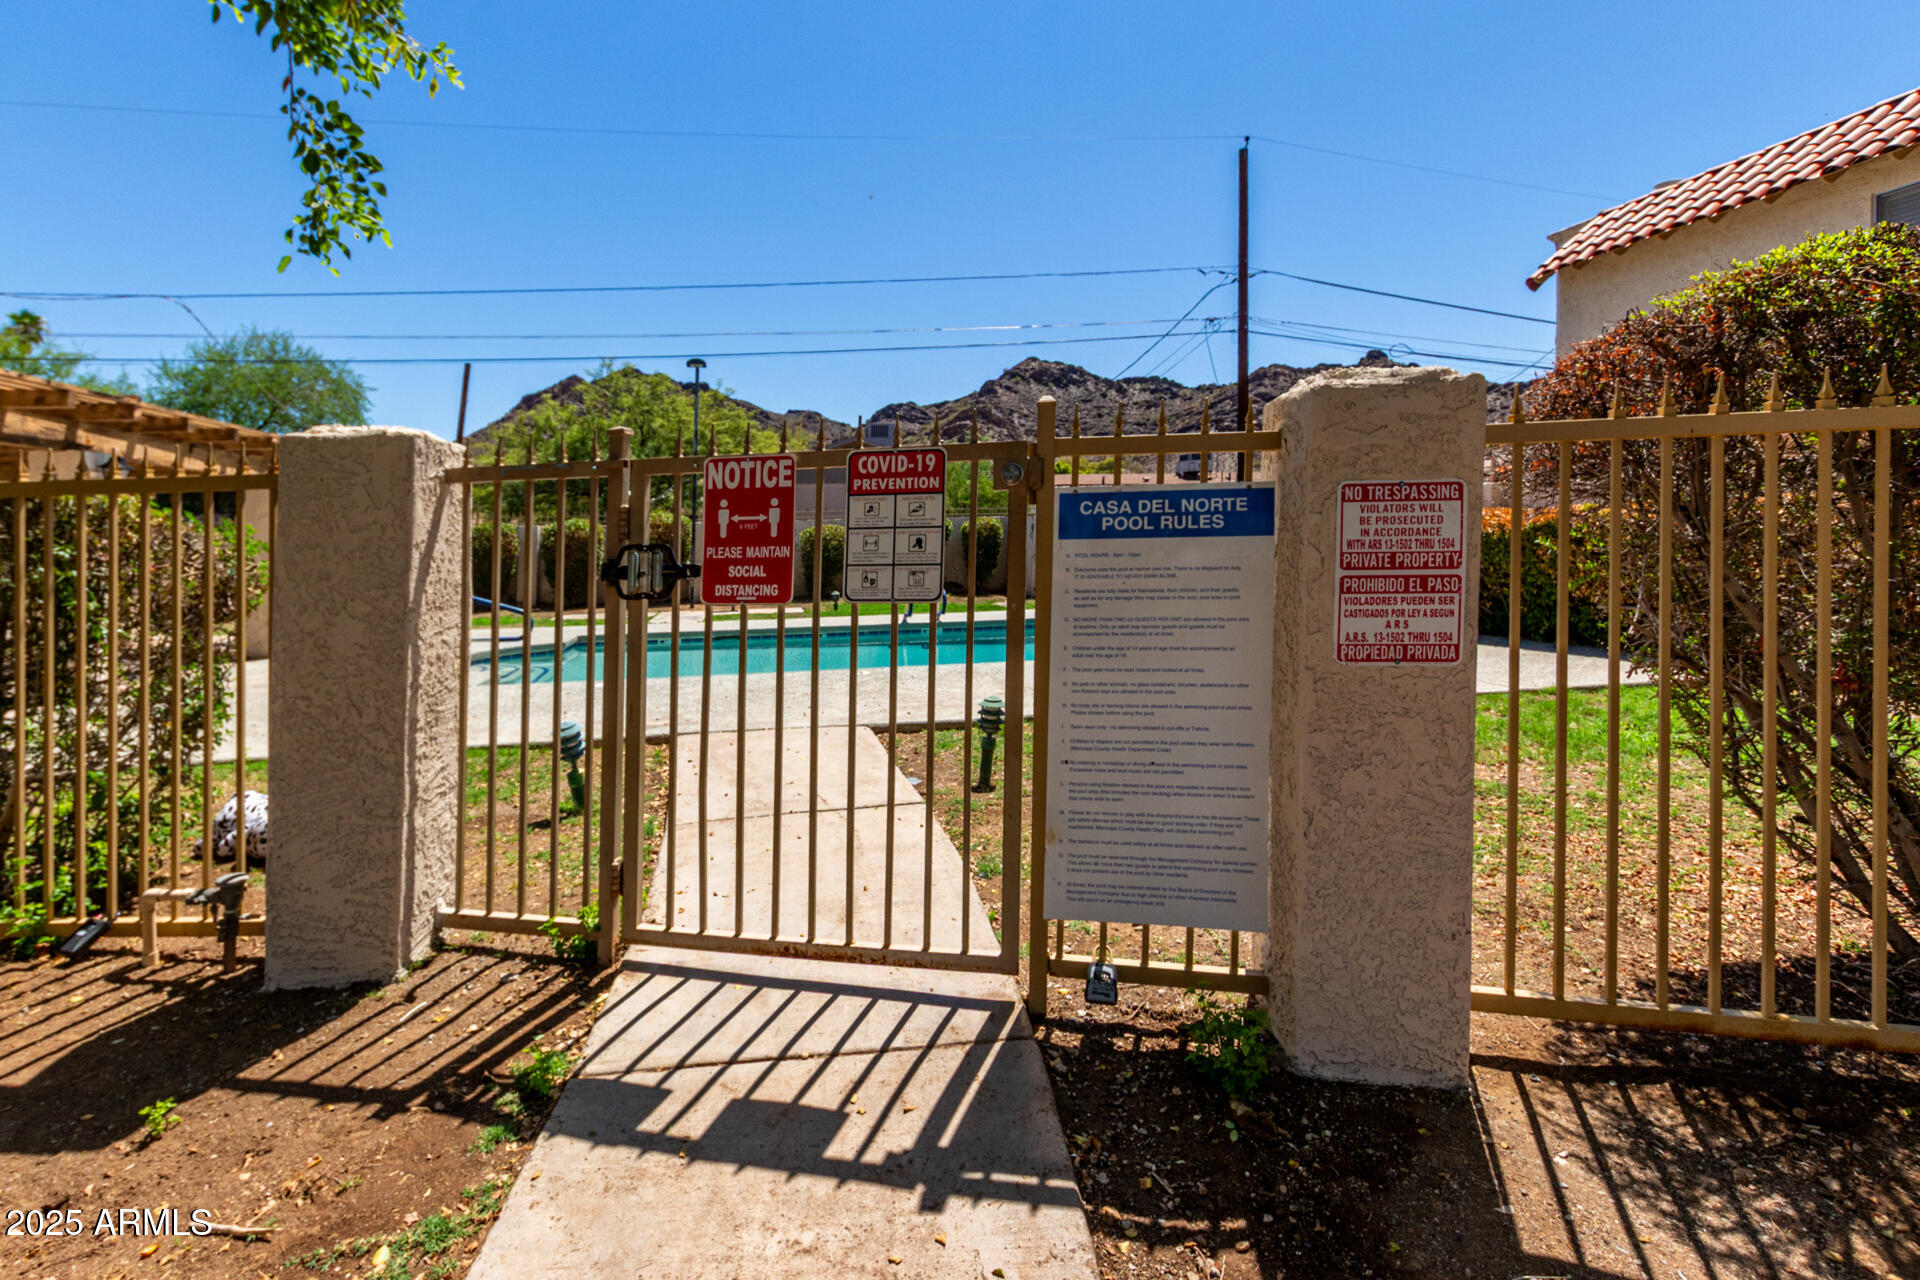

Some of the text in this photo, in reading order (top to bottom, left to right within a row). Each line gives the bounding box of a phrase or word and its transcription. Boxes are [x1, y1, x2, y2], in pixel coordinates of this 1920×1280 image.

[858, 454, 936, 474] COVID-19
[708, 459, 792, 490] NOTICE
[853, 476, 940, 491] PREVENTION
[1345, 484, 1459, 500] NO TRESPASSING
[1080, 497, 1248, 515] CASA DEL NORTE
[1360, 503, 1444, 513] VIOLATORS WILL
[1102, 515, 1225, 531] POOL RULES
[1360, 515, 1444, 526] BE PROSECUTED
[1360, 527, 1442, 537] IN ACCORDANCE
[1346, 538, 1455, 550] WITH ARS 13-1502 THRU 1504
[706, 546, 790, 559] PLEASE MAINTAIN
[1343, 552, 1460, 568] PRIVATE PROPERTY
[728, 565, 767, 577] SOCIAL
[715, 584, 779, 597] DISTANCING
[1343, 577, 1459, 592] PROHIBIDO EL PASO
[1344, 596, 1455, 606] VIOLADORES PUEDEN SER
[1344, 608, 1455, 618] CASTIGADOS POR LEY A SEGUN
[1373, 632, 1405, 642] 13-1502
[1407, 632, 1431, 642] THRU
[1433, 632, 1453, 642] 1504
[1341, 645, 1456, 660] PROPIEDAD PRIVADA
